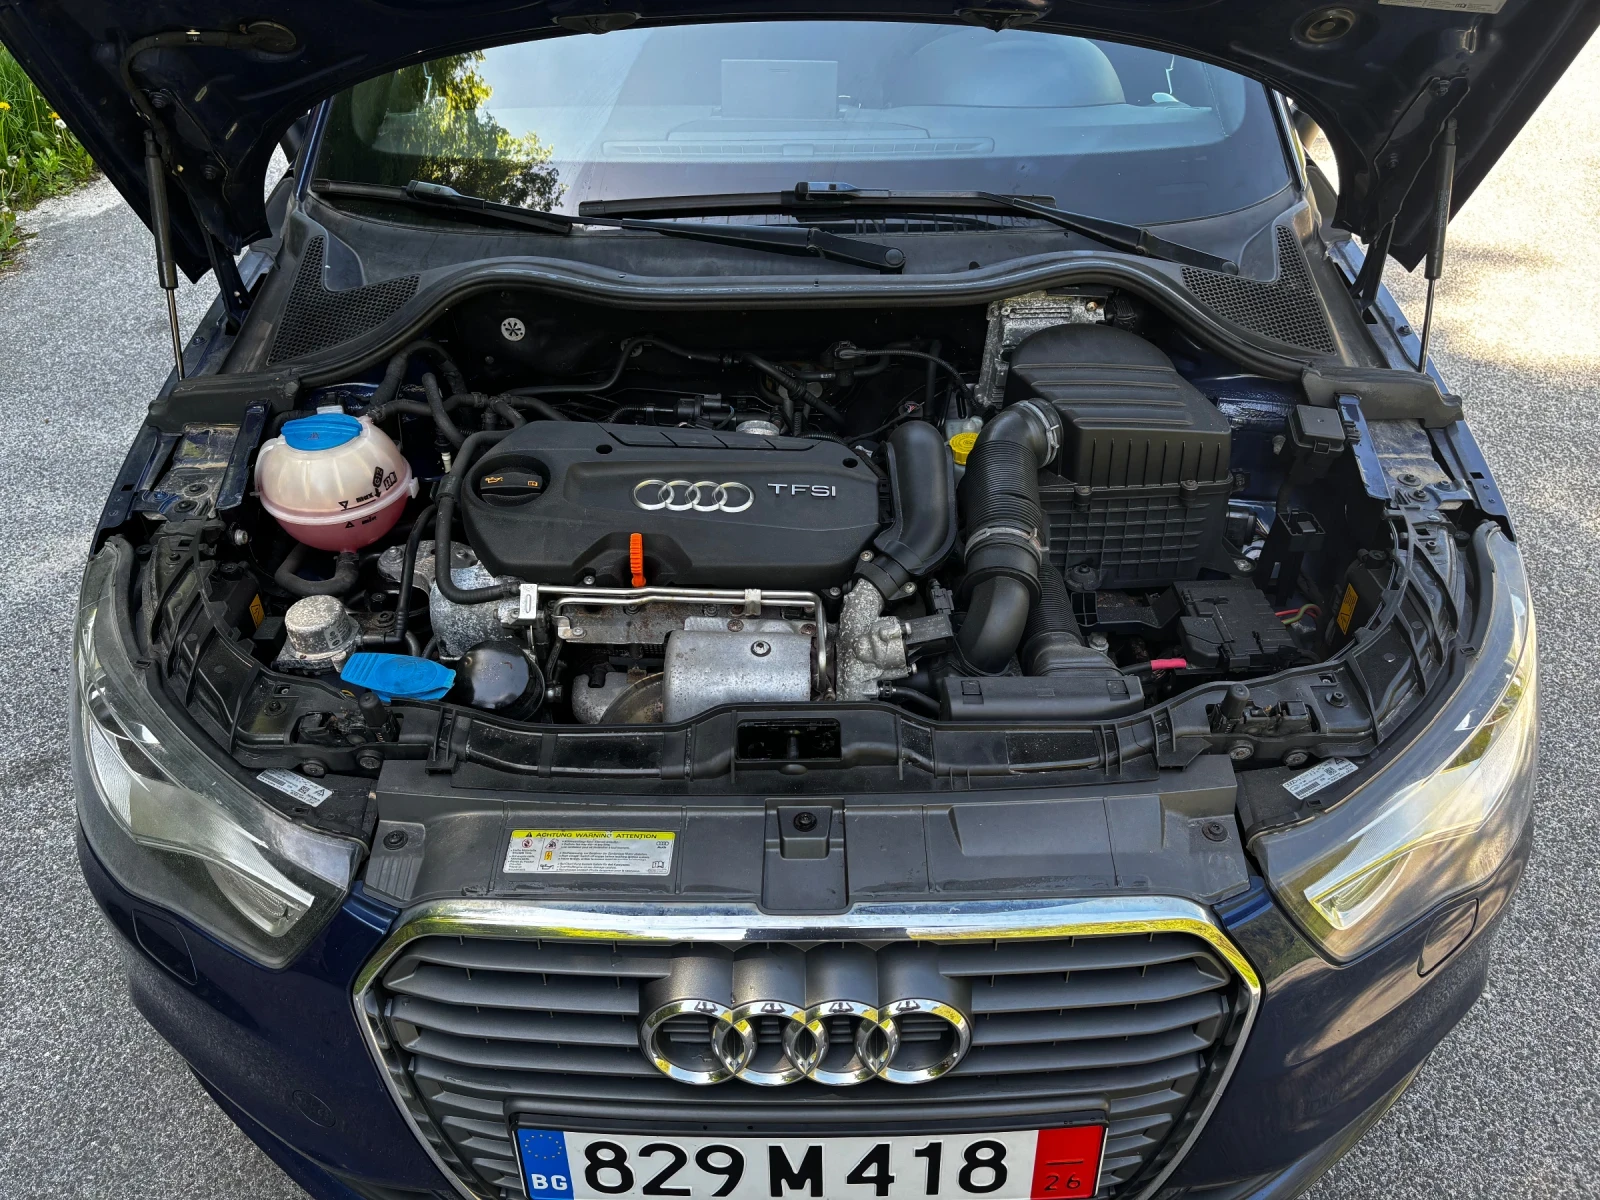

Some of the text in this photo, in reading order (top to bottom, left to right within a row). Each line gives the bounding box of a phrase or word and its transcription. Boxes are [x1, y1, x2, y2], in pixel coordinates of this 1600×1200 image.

[356, 492, 374, 503] max
[767, 483, 836, 497] TFSI
[362, 516, 376, 525] min
[584, 1140, 1008, 1198] 829 M 418
[531, 1174, 567, 1190] BG
[1043, 1174, 1081, 1192] 26
